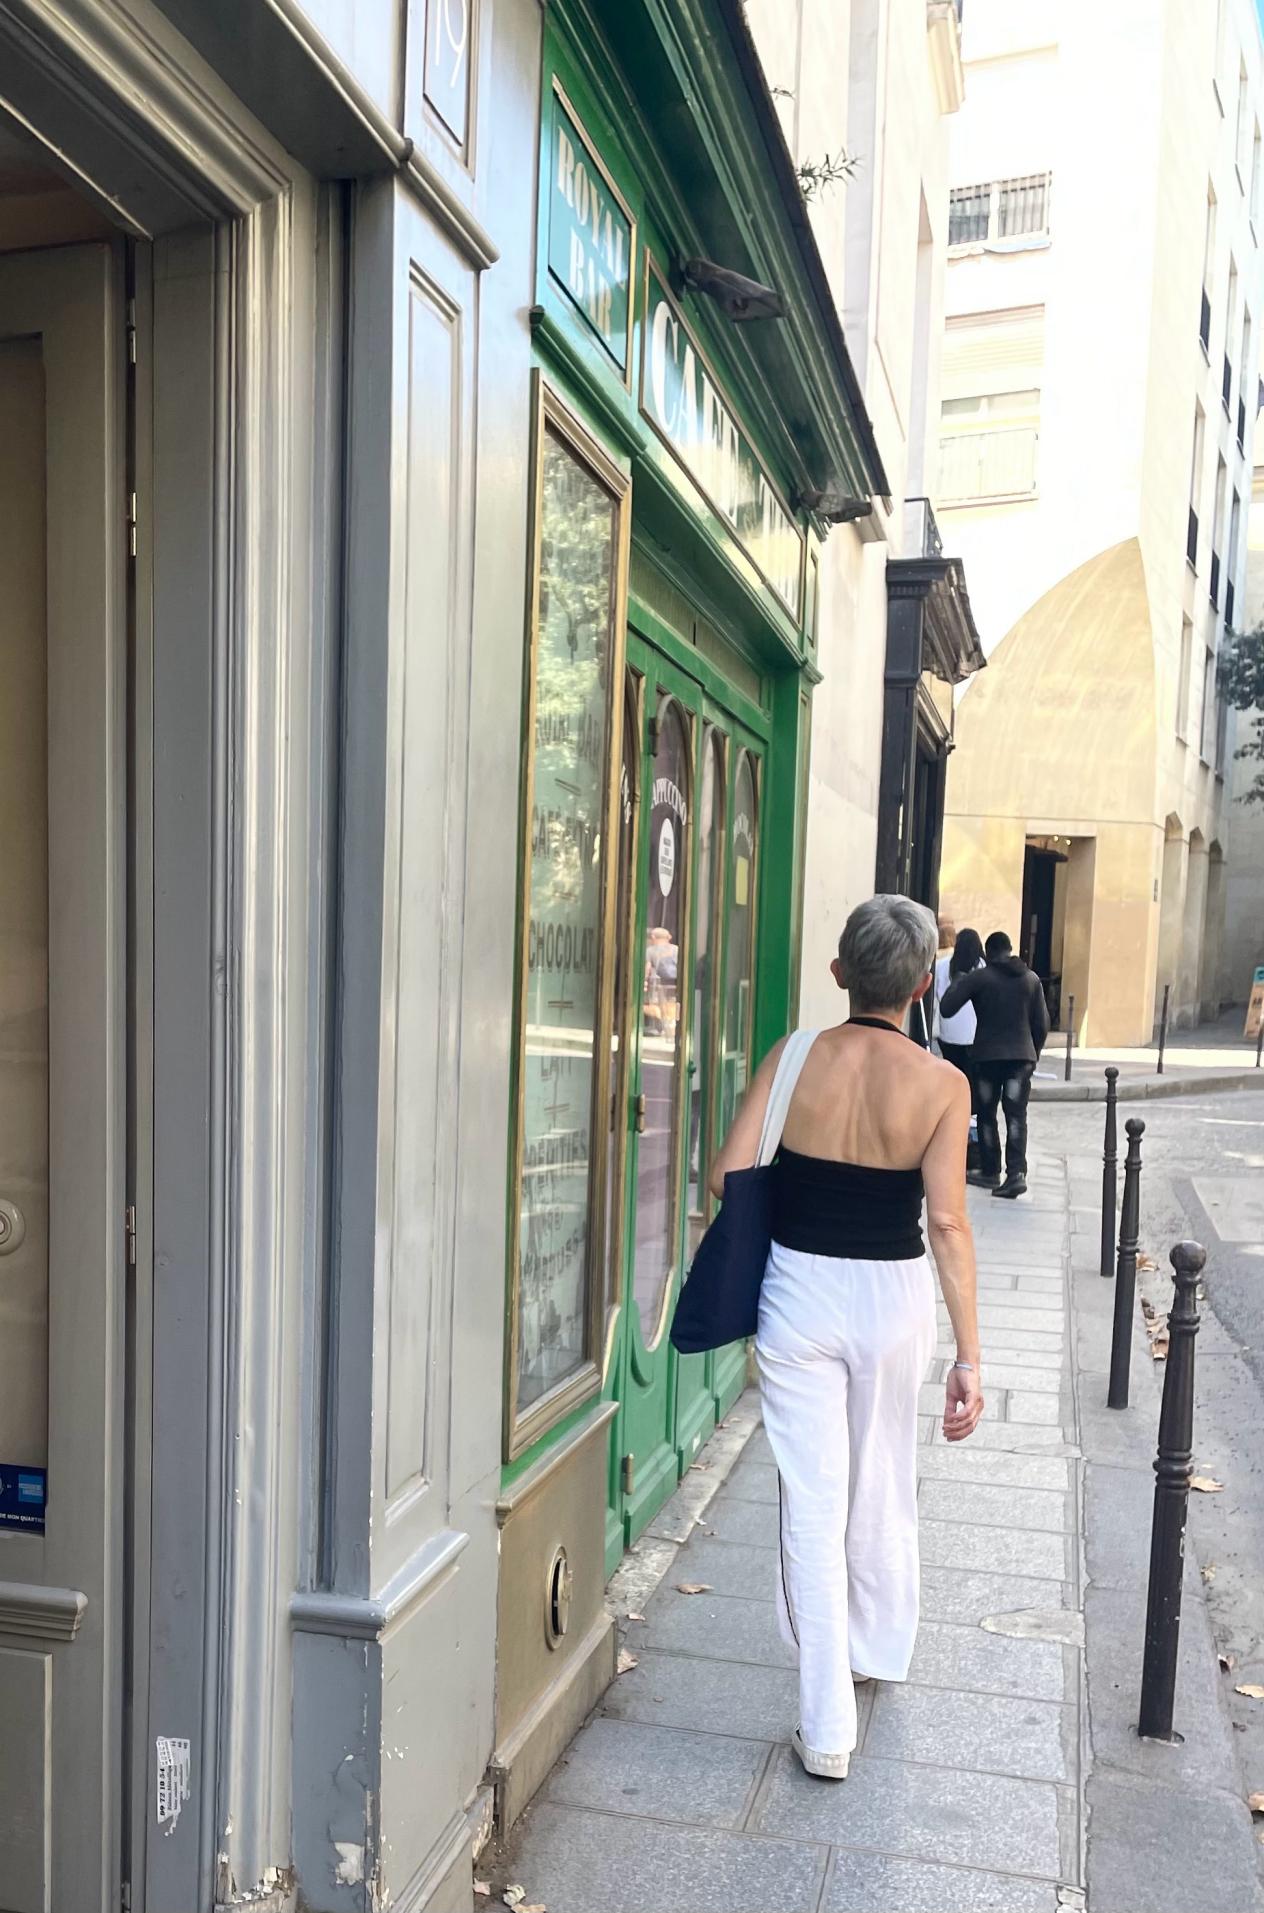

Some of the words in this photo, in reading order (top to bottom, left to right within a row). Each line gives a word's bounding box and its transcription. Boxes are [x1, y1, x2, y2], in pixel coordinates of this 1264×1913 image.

[557, 125, 625, 292] ROYAL
[569, 224, 612, 342] BAR
[527, 919, 594, 975] CHOCOLAT
